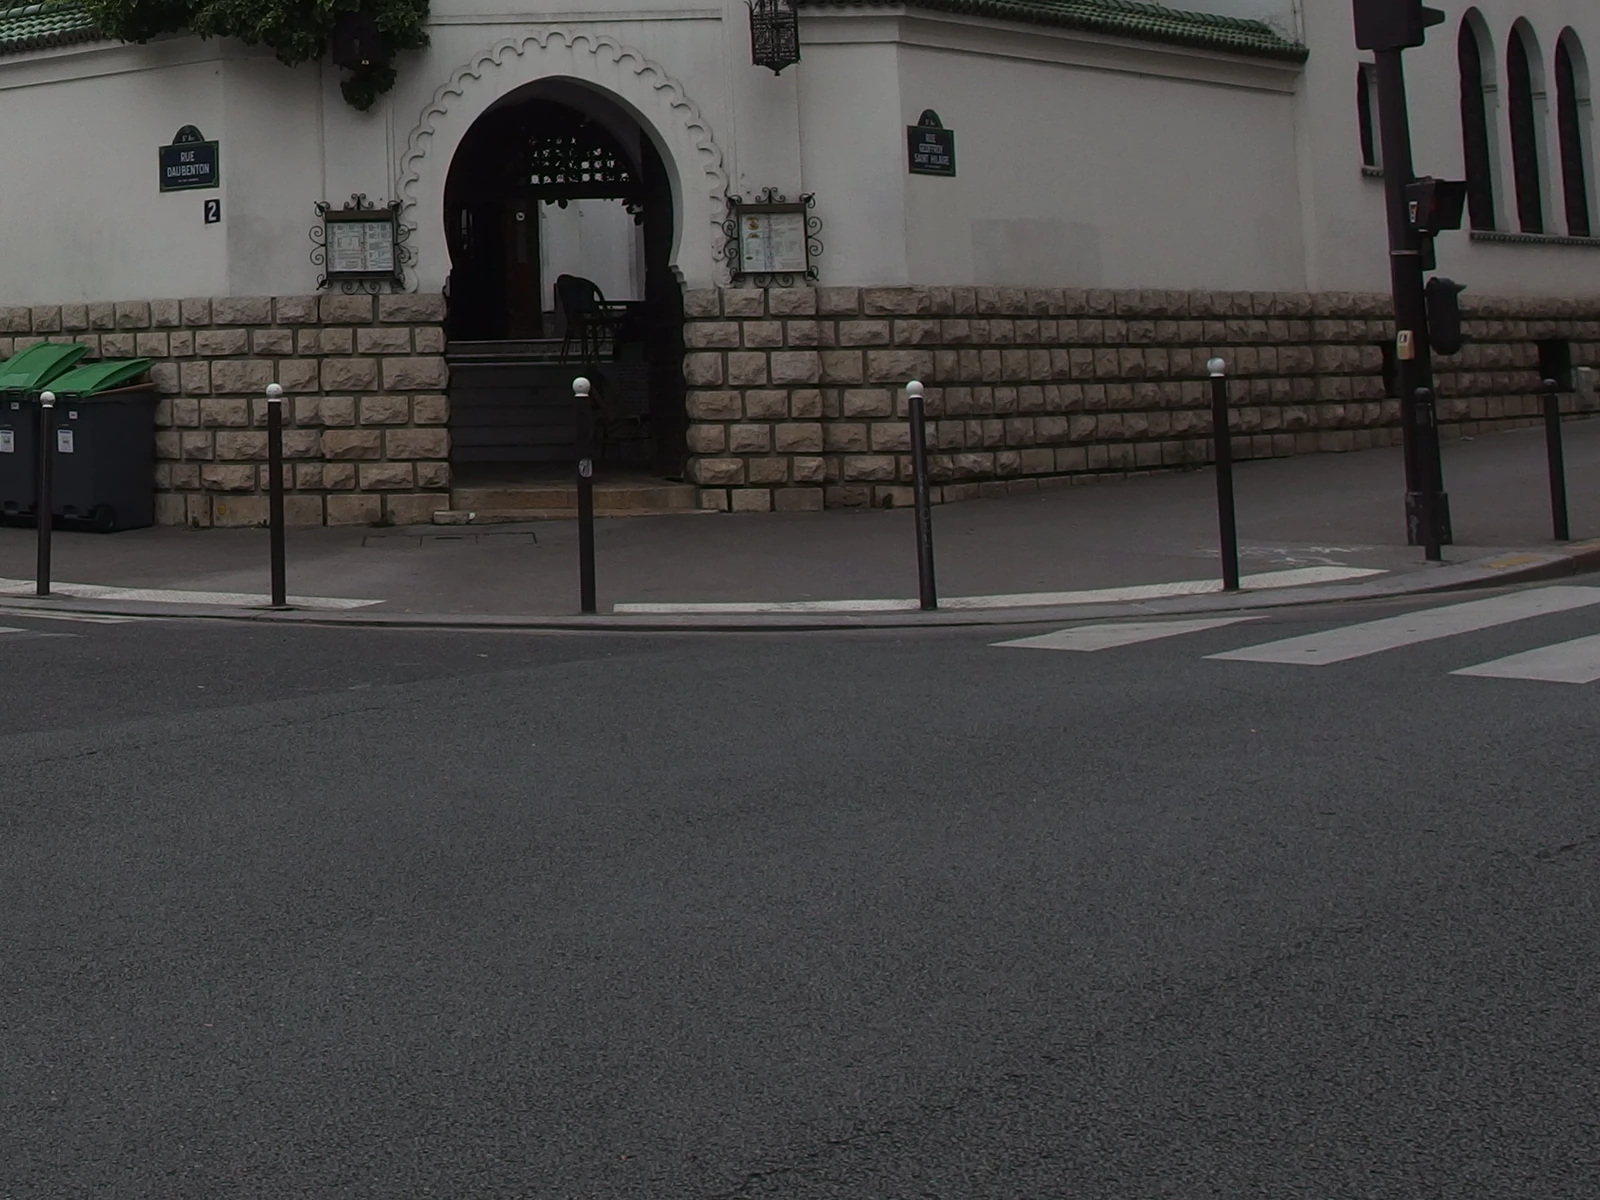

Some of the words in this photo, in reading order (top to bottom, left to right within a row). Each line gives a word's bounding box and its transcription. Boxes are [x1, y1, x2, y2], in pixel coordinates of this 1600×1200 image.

[180, 150, 195, 162] RUE
[166, 163, 210, 177] DAUBENTON
[207, 201, 217, 221] 2
